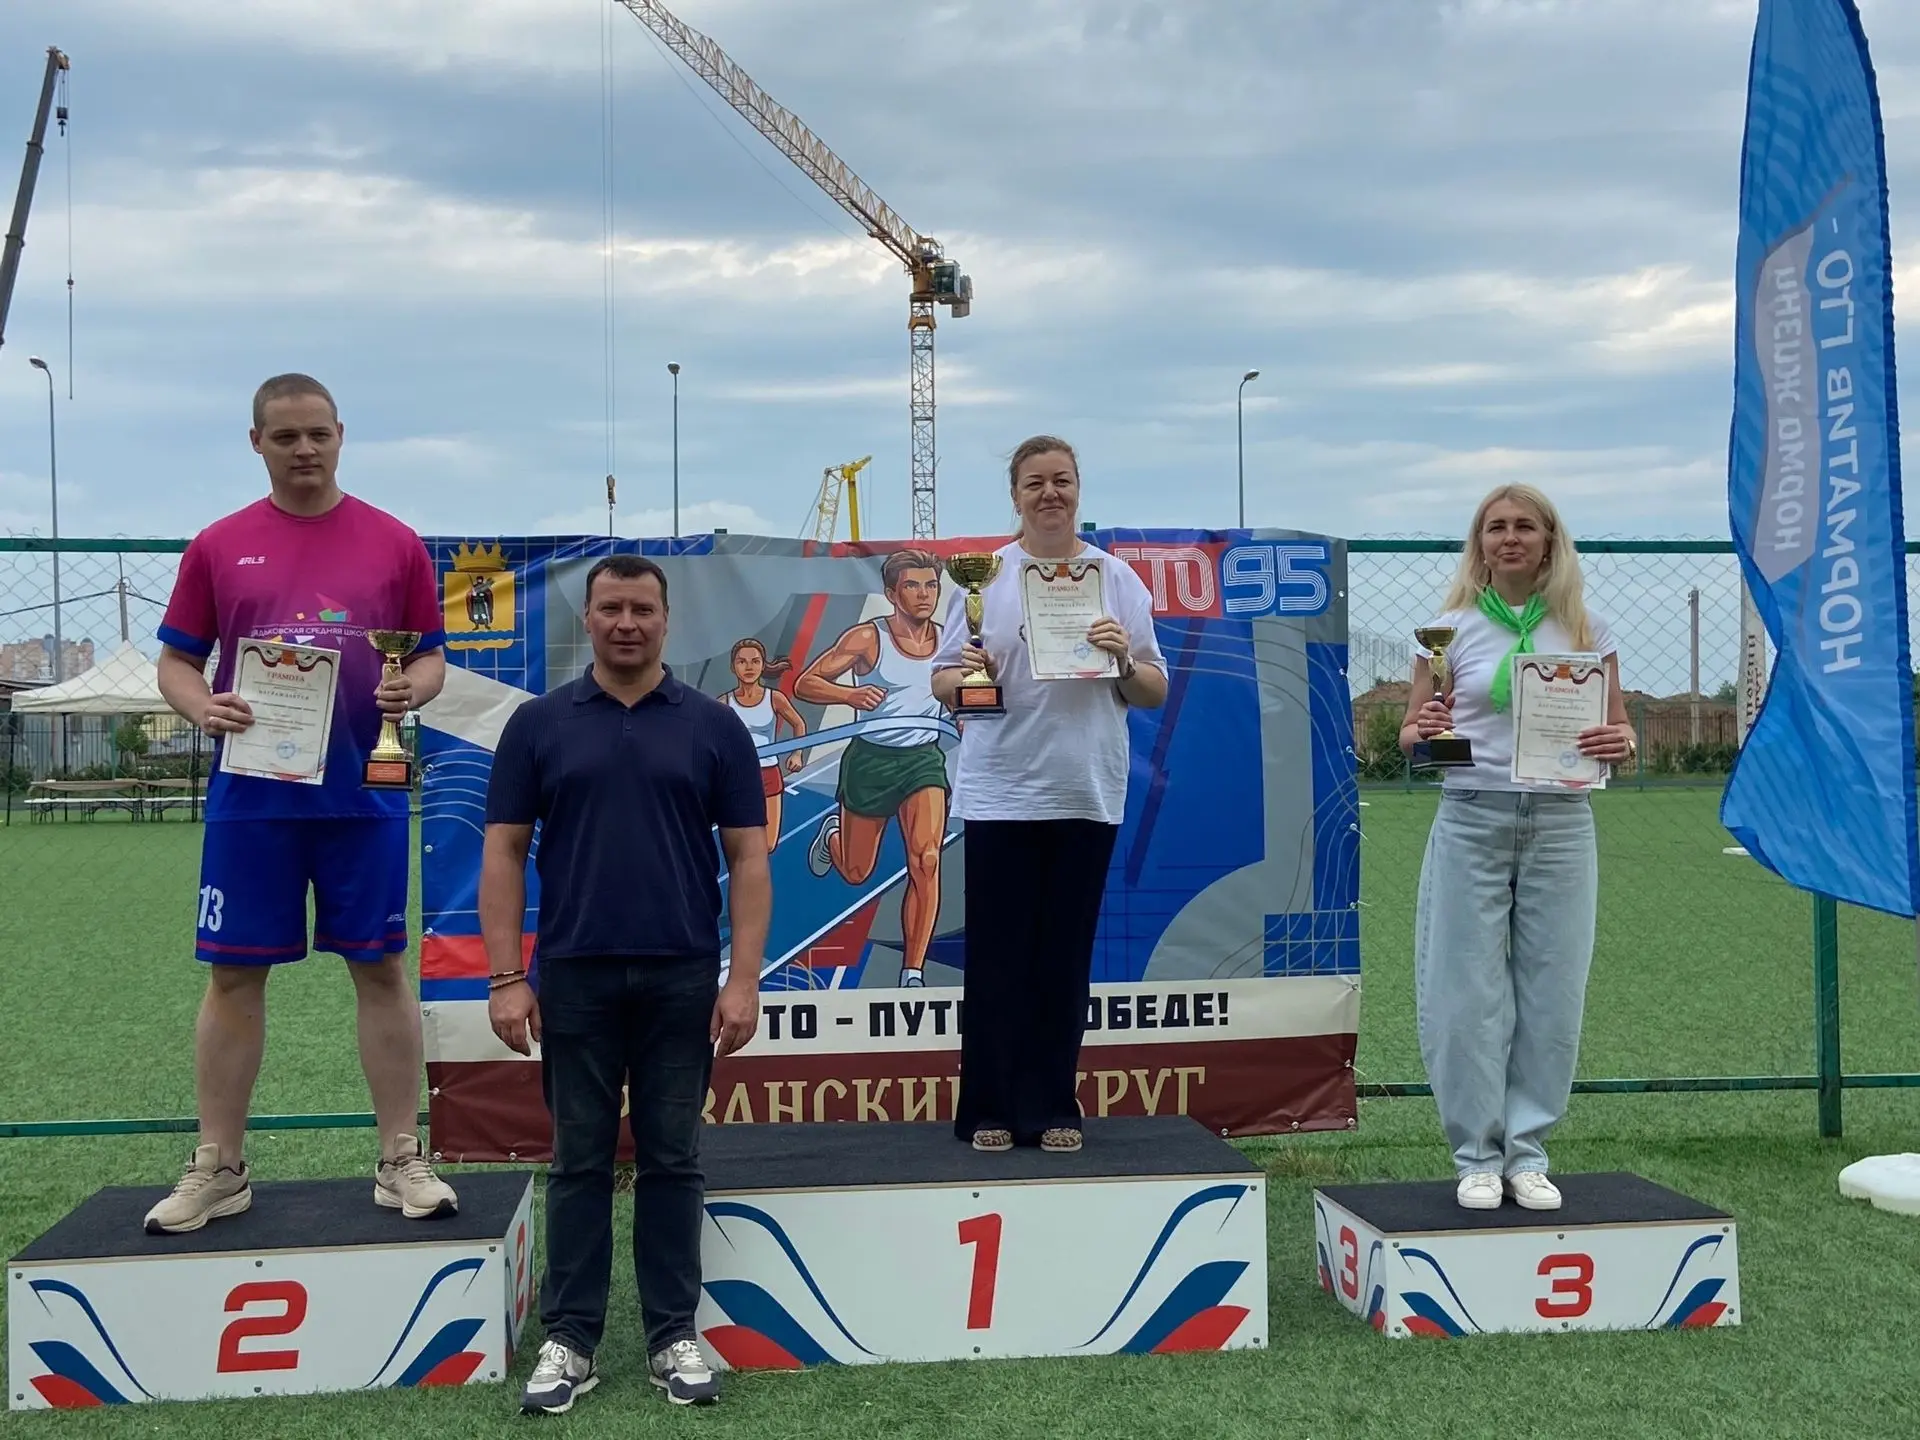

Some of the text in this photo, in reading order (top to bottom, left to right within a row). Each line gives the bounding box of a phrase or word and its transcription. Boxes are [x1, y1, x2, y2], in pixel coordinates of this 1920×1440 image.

[1222, 545, 1327, 613] 95
[198, 884, 225, 932] 13
[762, 1004, 818, 1040] ТО
[1086, 992, 1229, 1030] ОБЕДЕ!
[957, 1212, 1002, 1330] 1
[1339, 1225, 1359, 1300] 3
[1535, 1253, 1594, 1318] 3
[216, 1279, 309, 1374] 2
